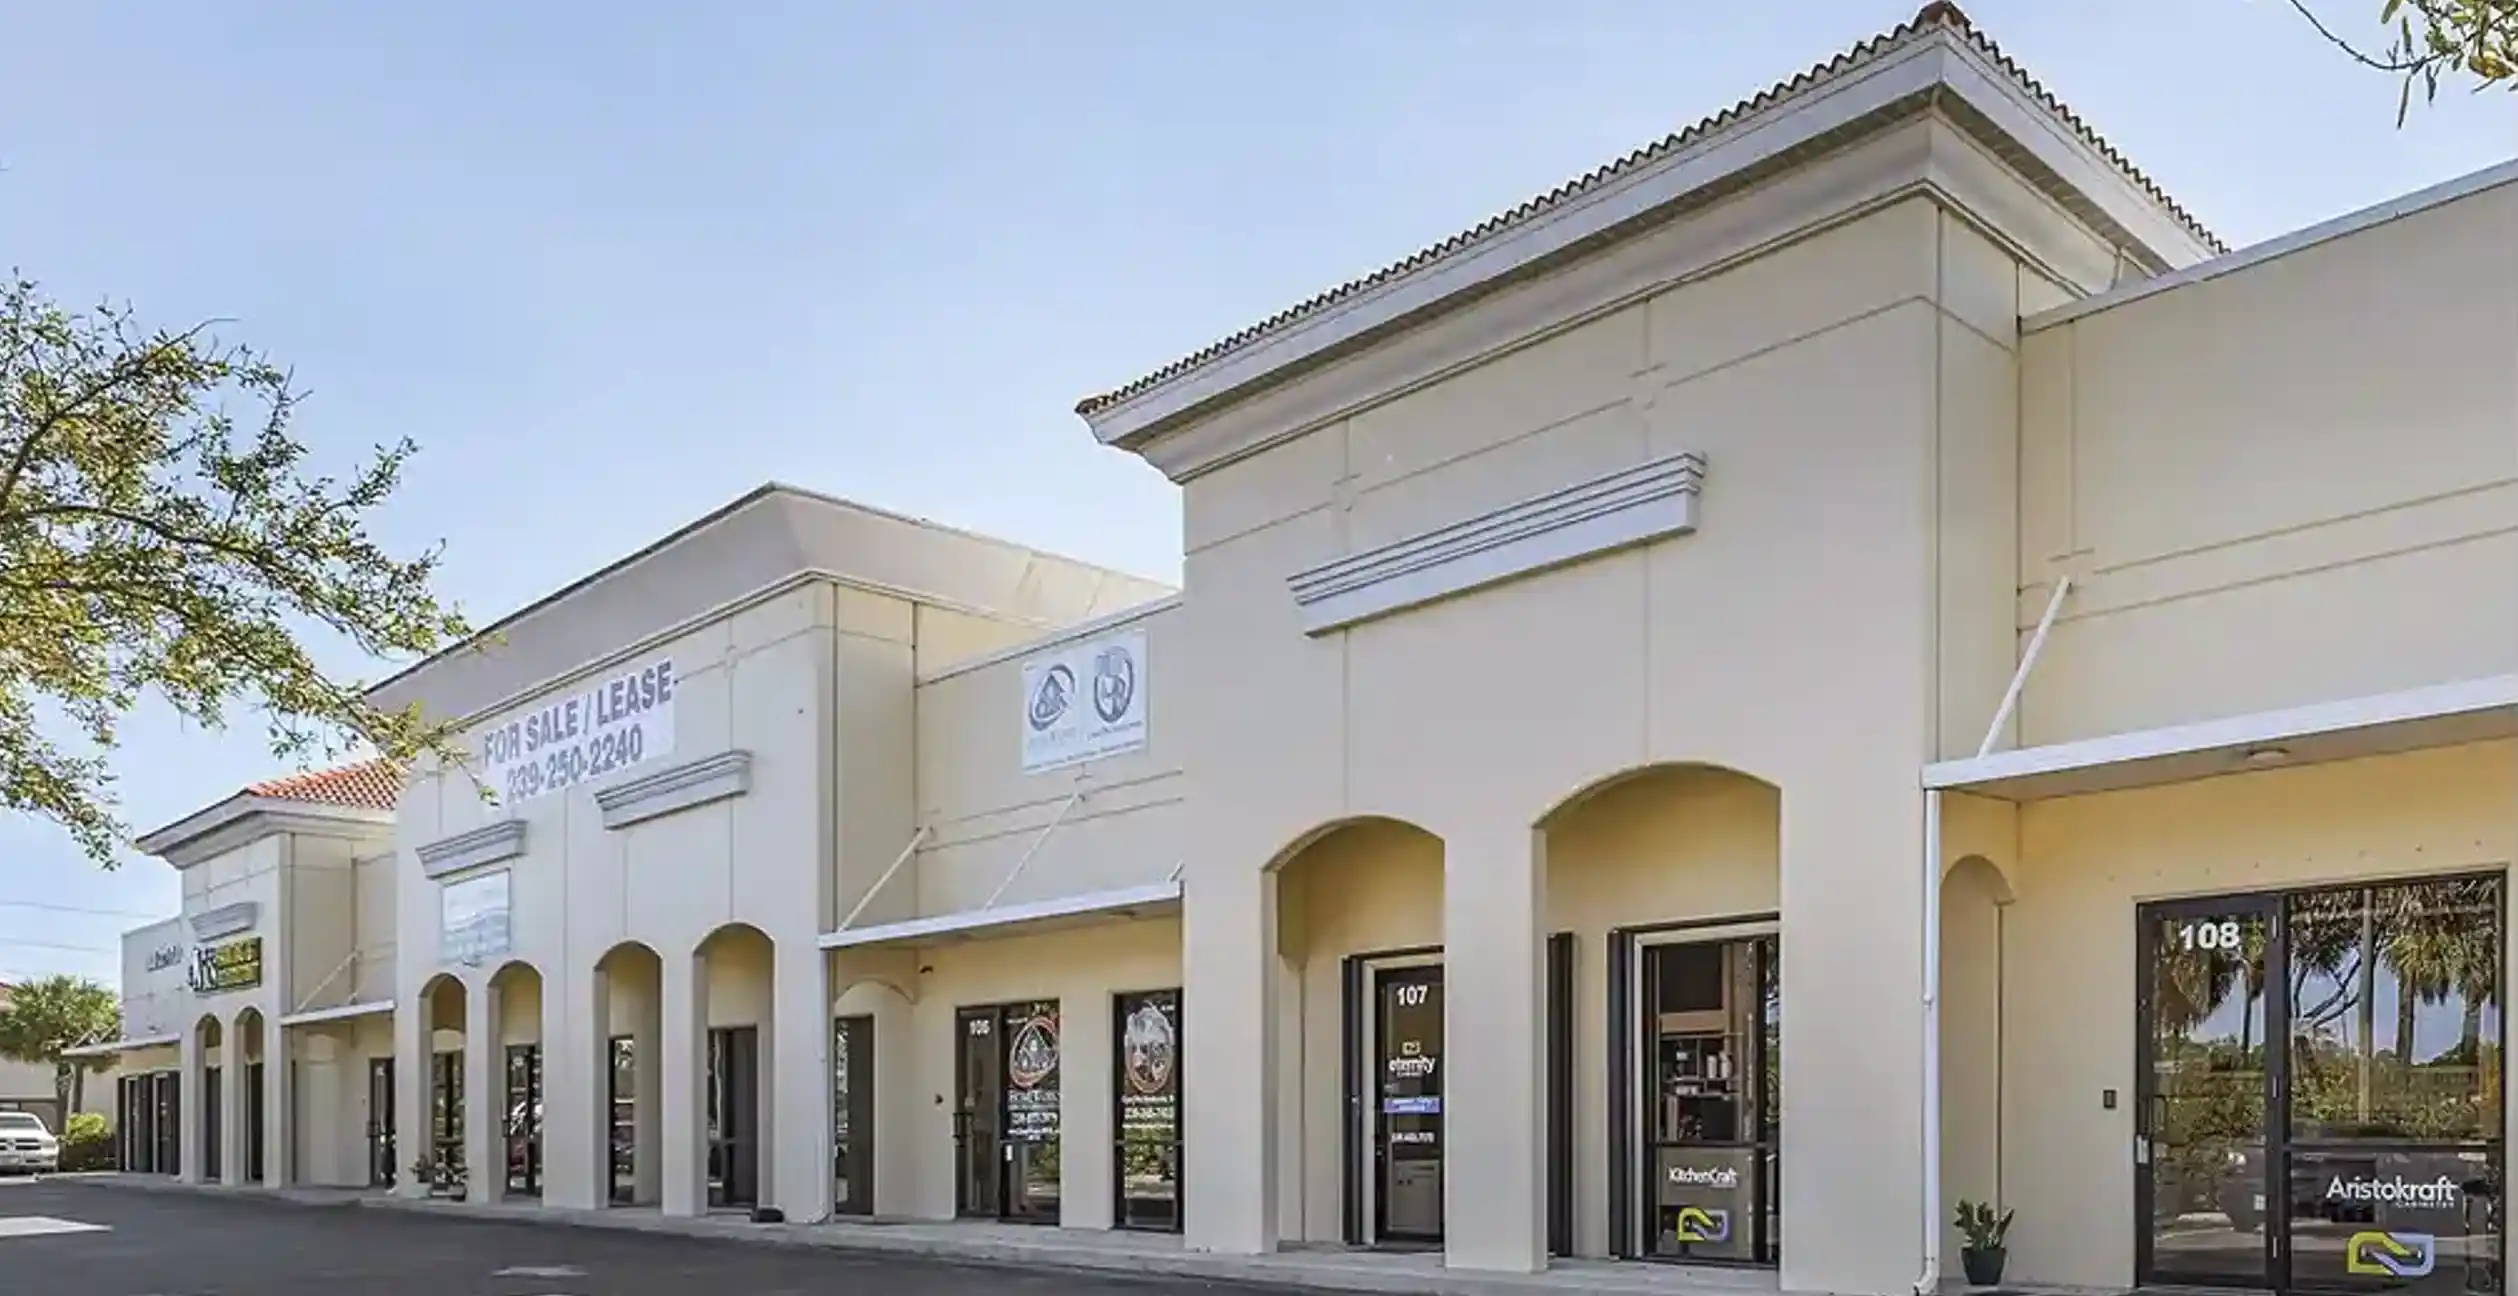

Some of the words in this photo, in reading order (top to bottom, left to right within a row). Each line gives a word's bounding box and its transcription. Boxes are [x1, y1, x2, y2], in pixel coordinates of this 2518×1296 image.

[484, 721, 521, 769] FOR
[526, 699, 579, 752] SALE
[596, 660, 672, 727] LEASE
[507, 722, 643, 802] 239-250-2240
[2179, 921, 2240, 951] 108
[1396, 984, 1429, 1006] 107
[1388, 1055, 1436, 1074] eternity
[2325, 1174, 2460, 1202] Aristokraft
